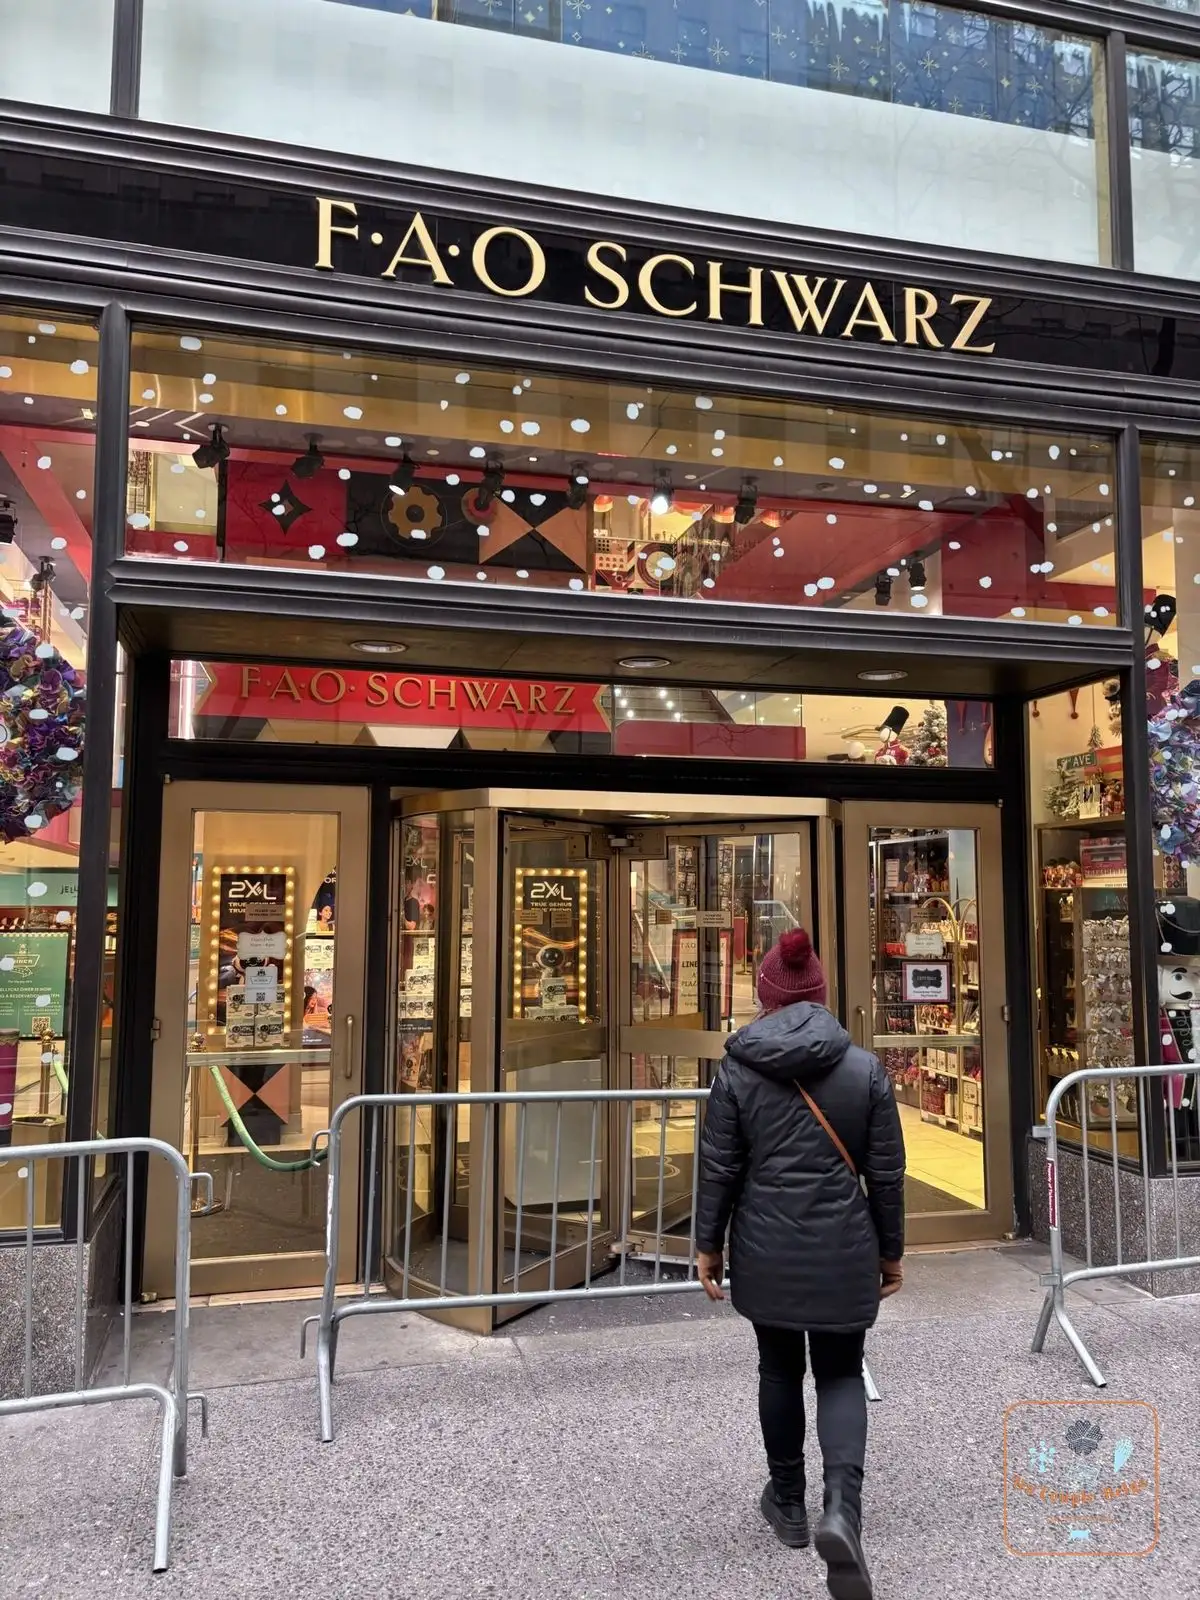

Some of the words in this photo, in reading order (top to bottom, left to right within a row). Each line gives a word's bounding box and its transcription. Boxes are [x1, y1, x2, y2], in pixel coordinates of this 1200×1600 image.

[584, 241, 996, 354] SCHWARZ
[365, 672, 576, 715] SCHWARZ
[1072, 754, 1091, 767] AVE
